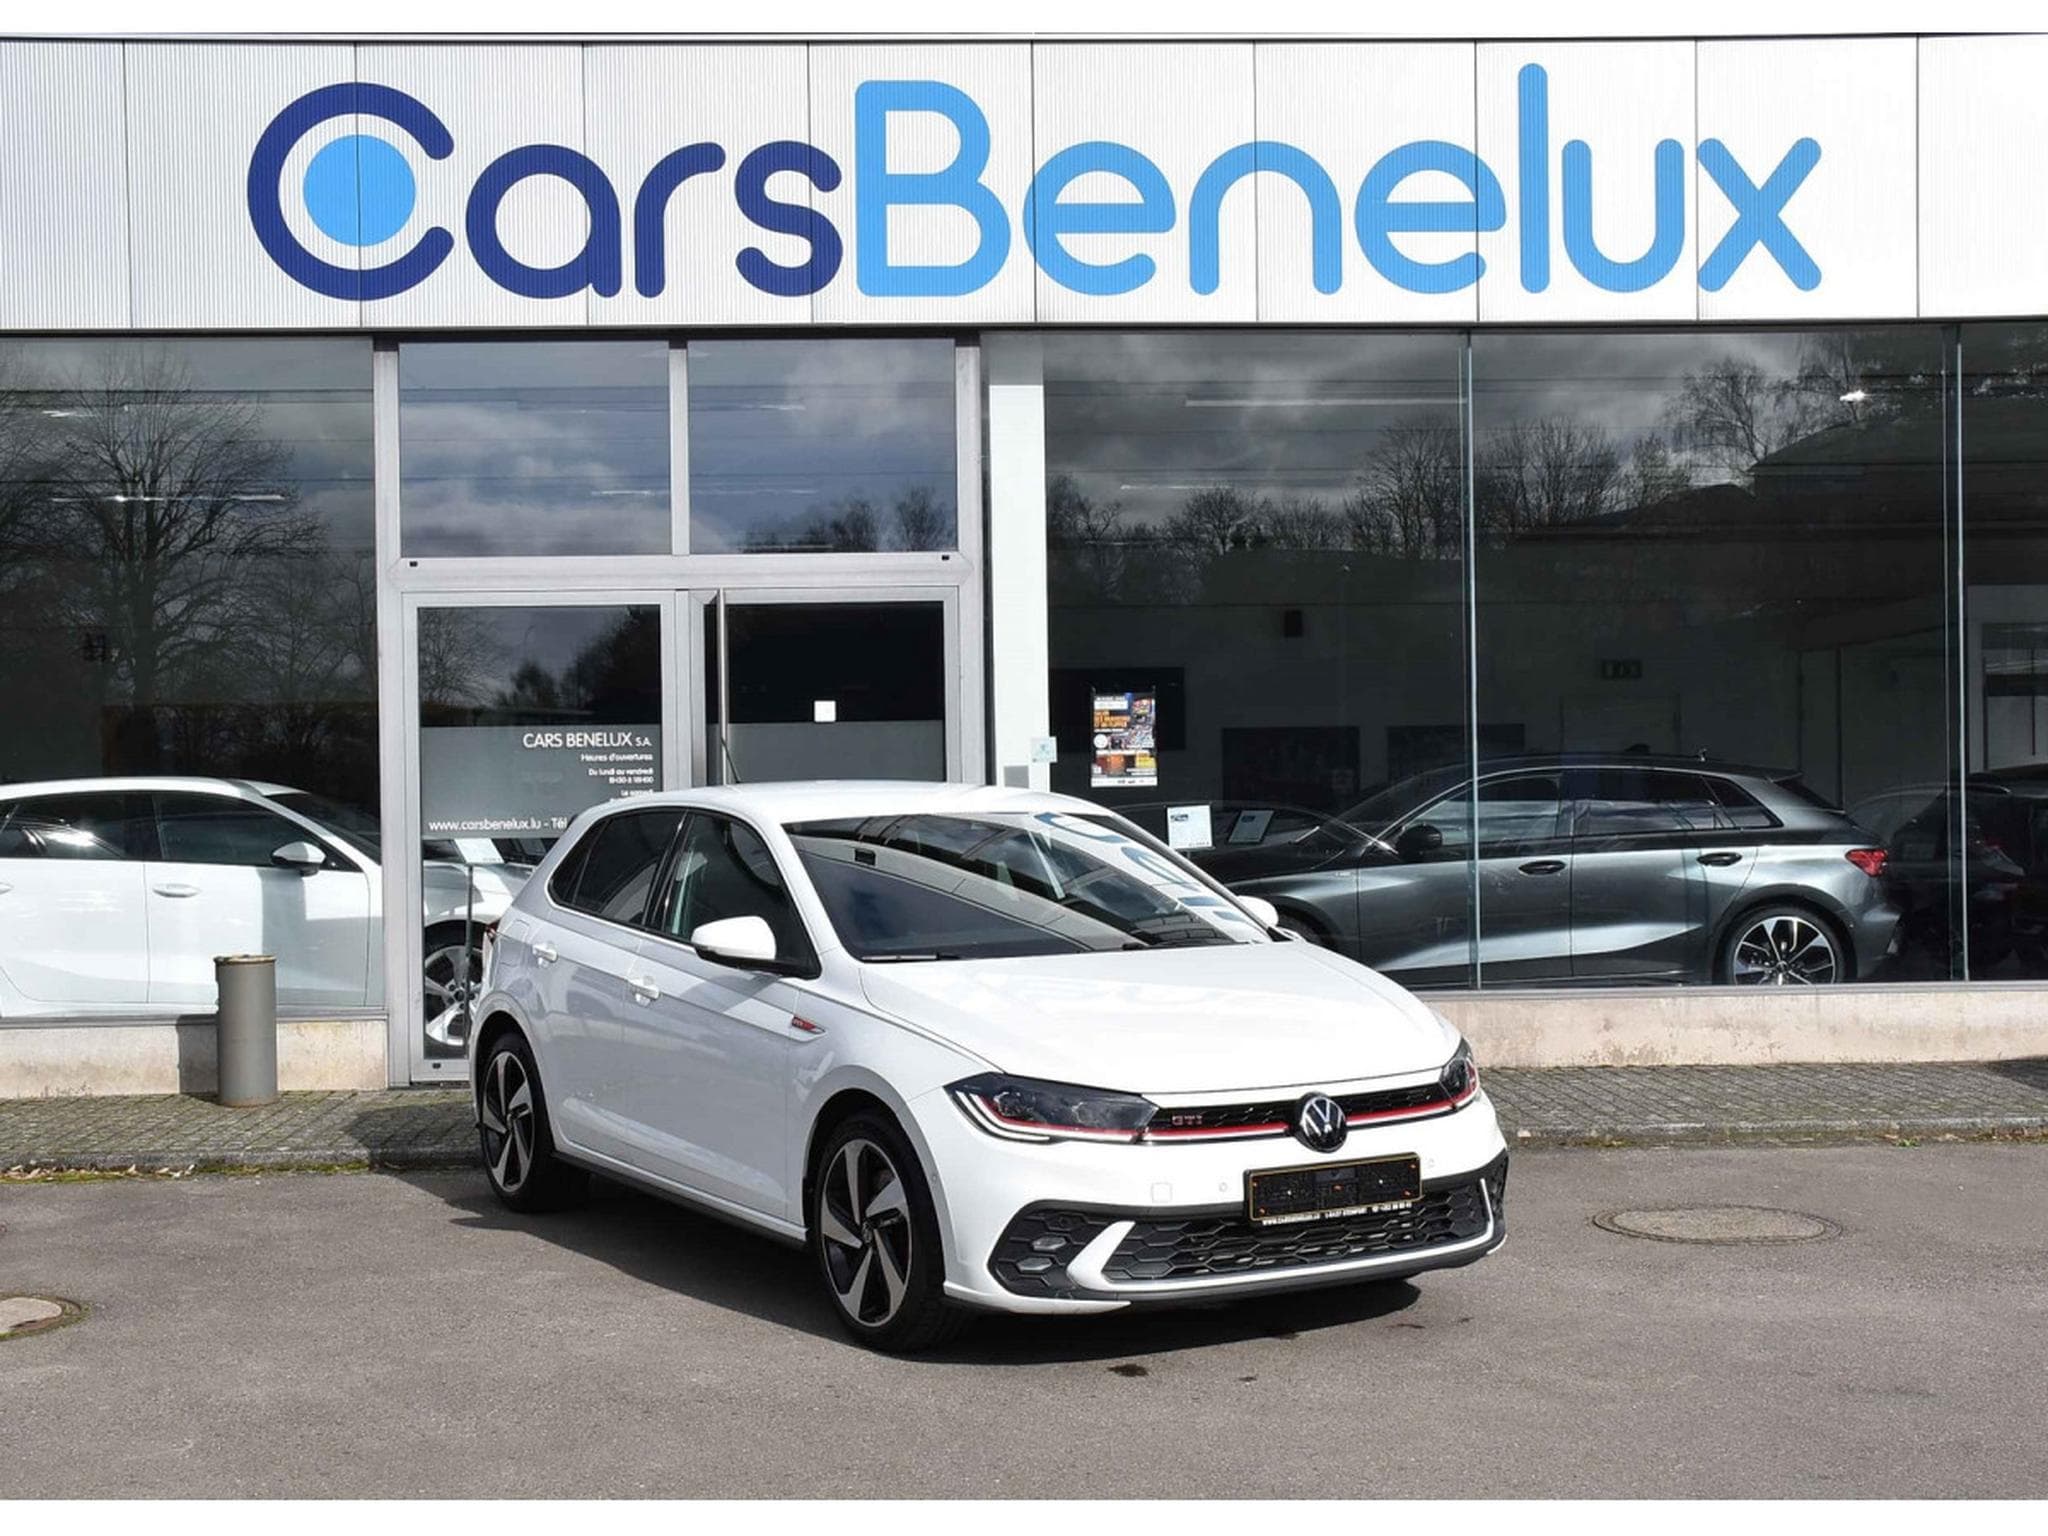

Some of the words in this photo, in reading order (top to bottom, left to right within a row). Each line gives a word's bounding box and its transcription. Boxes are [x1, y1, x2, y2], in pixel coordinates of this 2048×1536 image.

[522, 732, 563, 748] CARS
[566, 732, 632, 747] BENELUX
[581, 753, 607, 761] Heures
[429, 817, 541, 831] www.carsbenelux.lu
[1172, 1114, 1202, 1125] GTI
